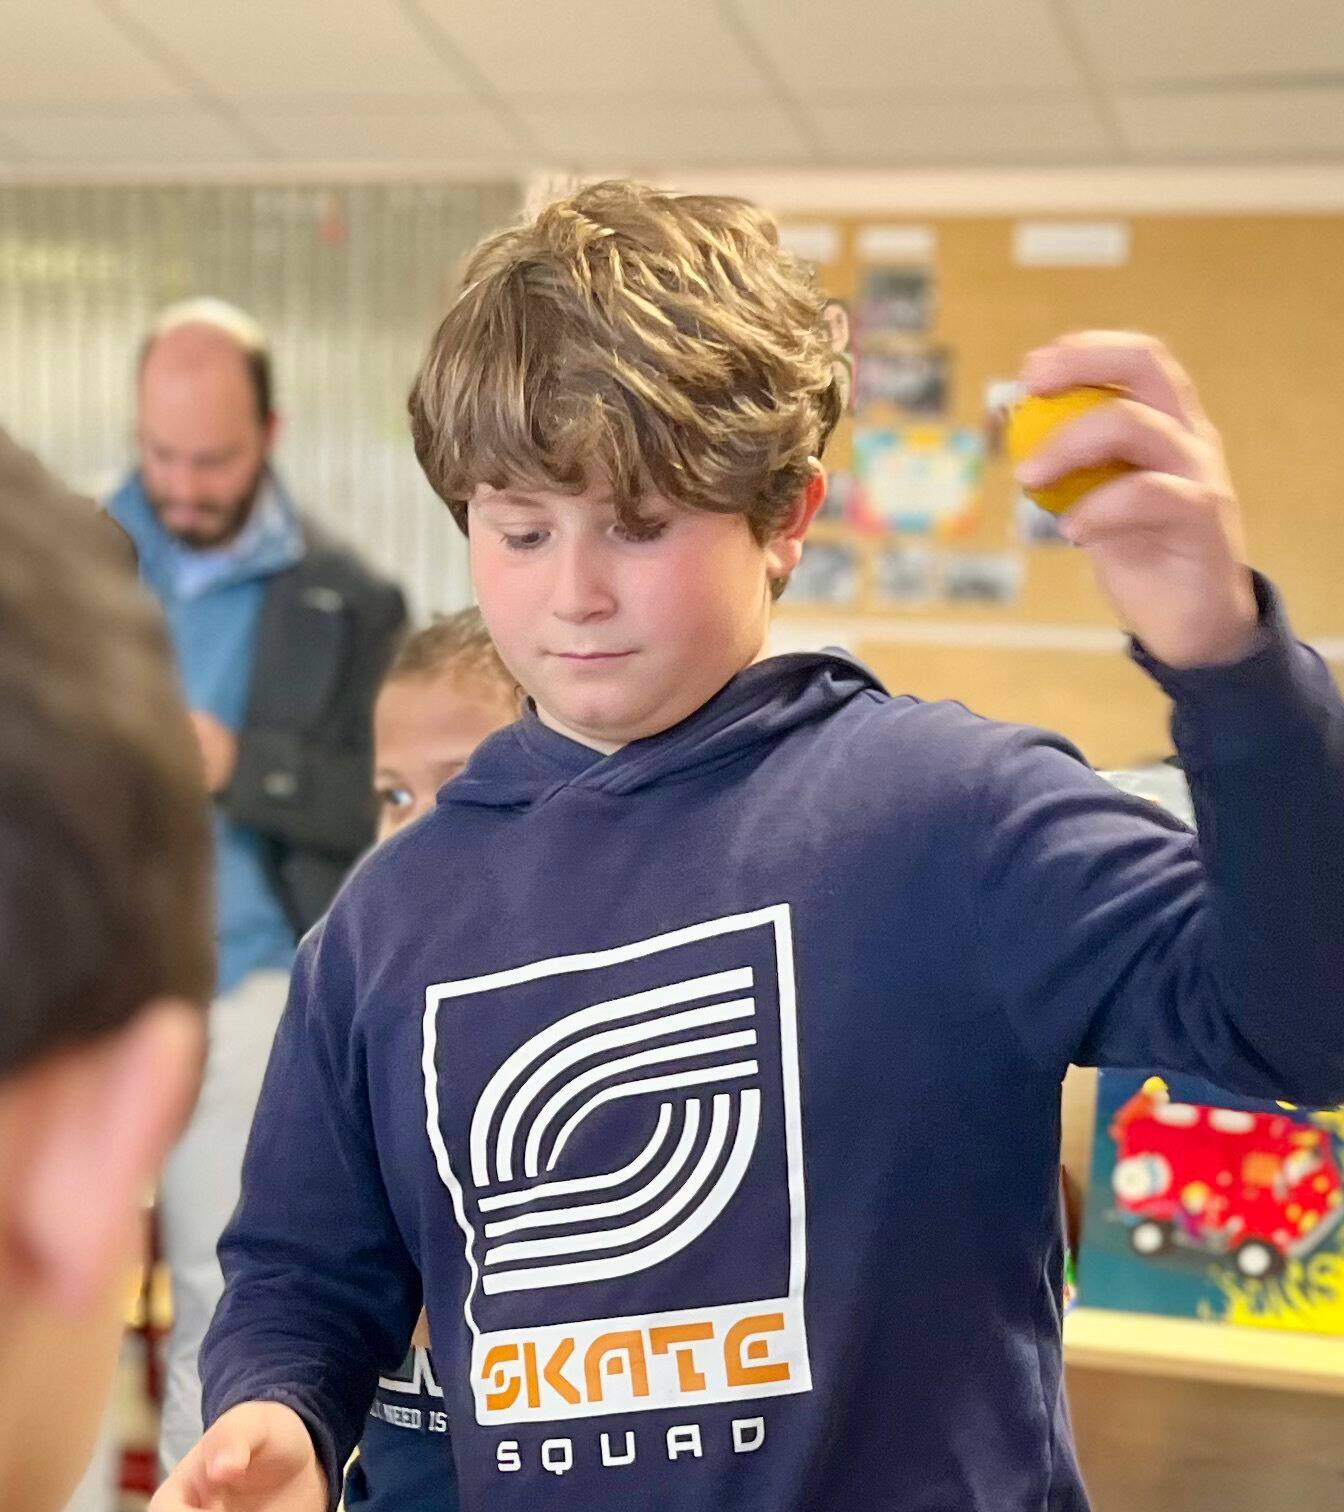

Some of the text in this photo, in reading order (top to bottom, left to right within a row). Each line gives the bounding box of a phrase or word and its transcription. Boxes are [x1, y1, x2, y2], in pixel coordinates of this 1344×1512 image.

[481, 1312, 791, 1411] SKATE
[428, 1411, 448, 1433] IS
[496, 1416, 766, 1475] SQUAD
